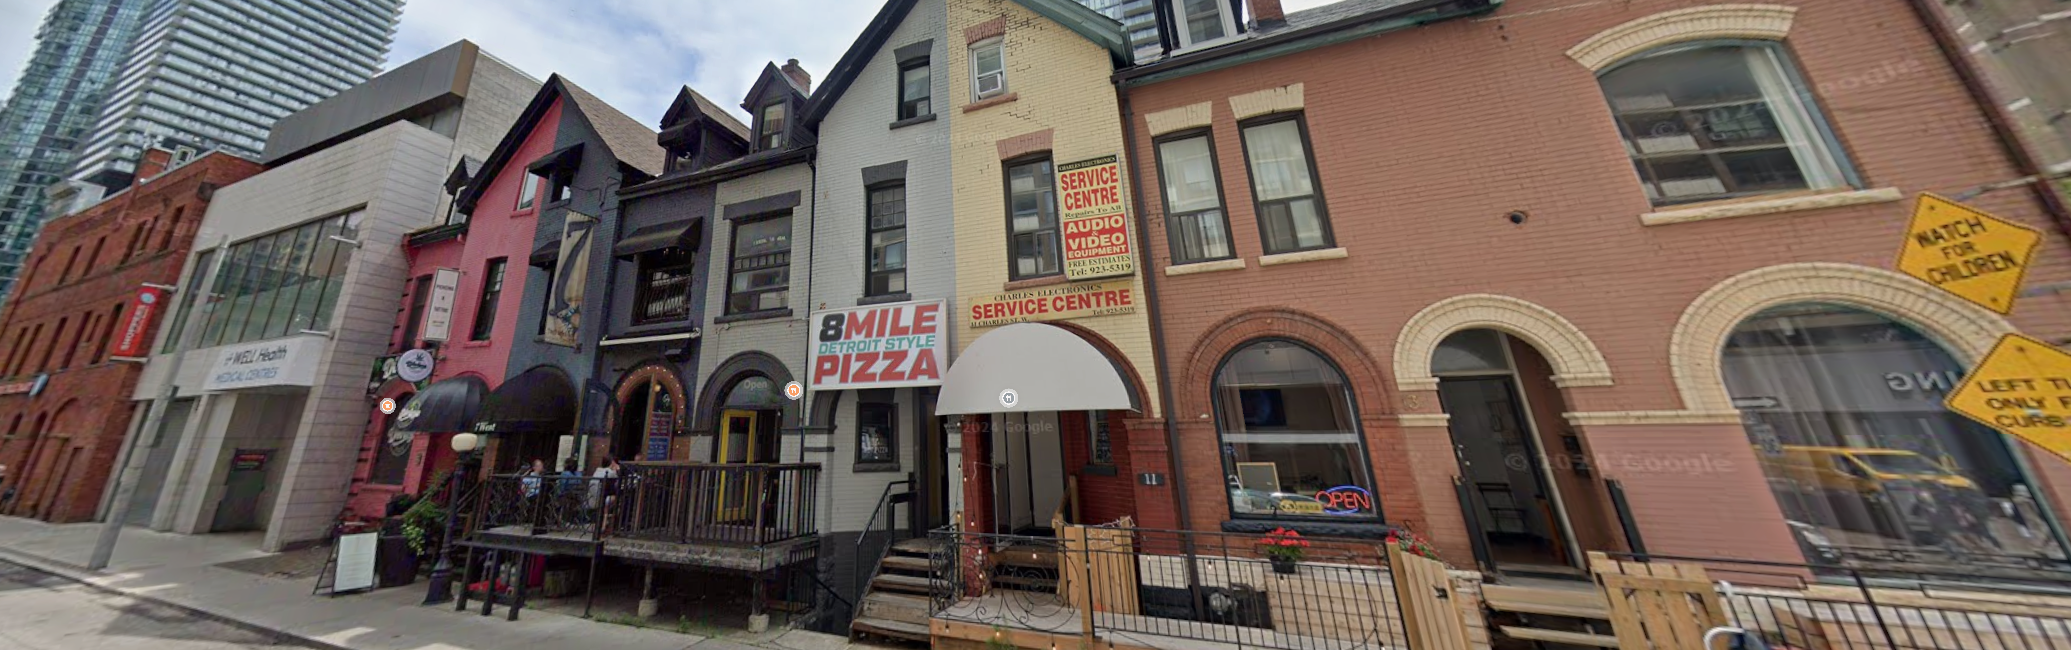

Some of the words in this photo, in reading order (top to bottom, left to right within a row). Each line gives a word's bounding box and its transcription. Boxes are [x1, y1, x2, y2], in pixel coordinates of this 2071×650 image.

[1058, 163, 1081, 171] CHARLES
[1081, 156, 1116, 168] ELECTRONICS
[1060, 165, 1119, 192] SERVICE
[1064, 185, 1120, 211] CENTRE
[1065, 209, 1095, 218] Repairs
[1066, 215, 1124, 234] AUDIO
[1915, 215, 1987, 248] WATCH
[1067, 232, 1125, 250] VIDEO
[1067, 244, 1127, 259] EQUIPMENT
[1940, 241, 1976, 260] FOR
[1068, 260, 1088, 268] FREE
[1088, 254, 1131, 266] ESTIMATES
[1068, 268, 1087, 277] Tel:
[1089, 263, 1131, 274] 923-5319
[1927, 250, 2015, 285] CHILDREN
[994, 291, 1034, 302] CHARLES
[1037, 283, 1103, 297] ELECTRONICS
[971, 297, 1049, 321] SERVICE
[1051, 288, 1133, 313] CENTRE
[1106, 306, 1135, 315] 923-5319
[978, 318, 1009, 327] CHARLES
[818, 339, 881, 355] DETROIT
[884, 334, 936, 351] STYLE
[812, 348, 941, 385] PIZZA
[743, 379, 768, 390] Open
[1978, 378, 2036, 393] LEFT
[1986, 397, 2047, 410] ONLY
[1145, 473, 1158, 485] 11
[1315, 490, 1371, 509] OPEN
